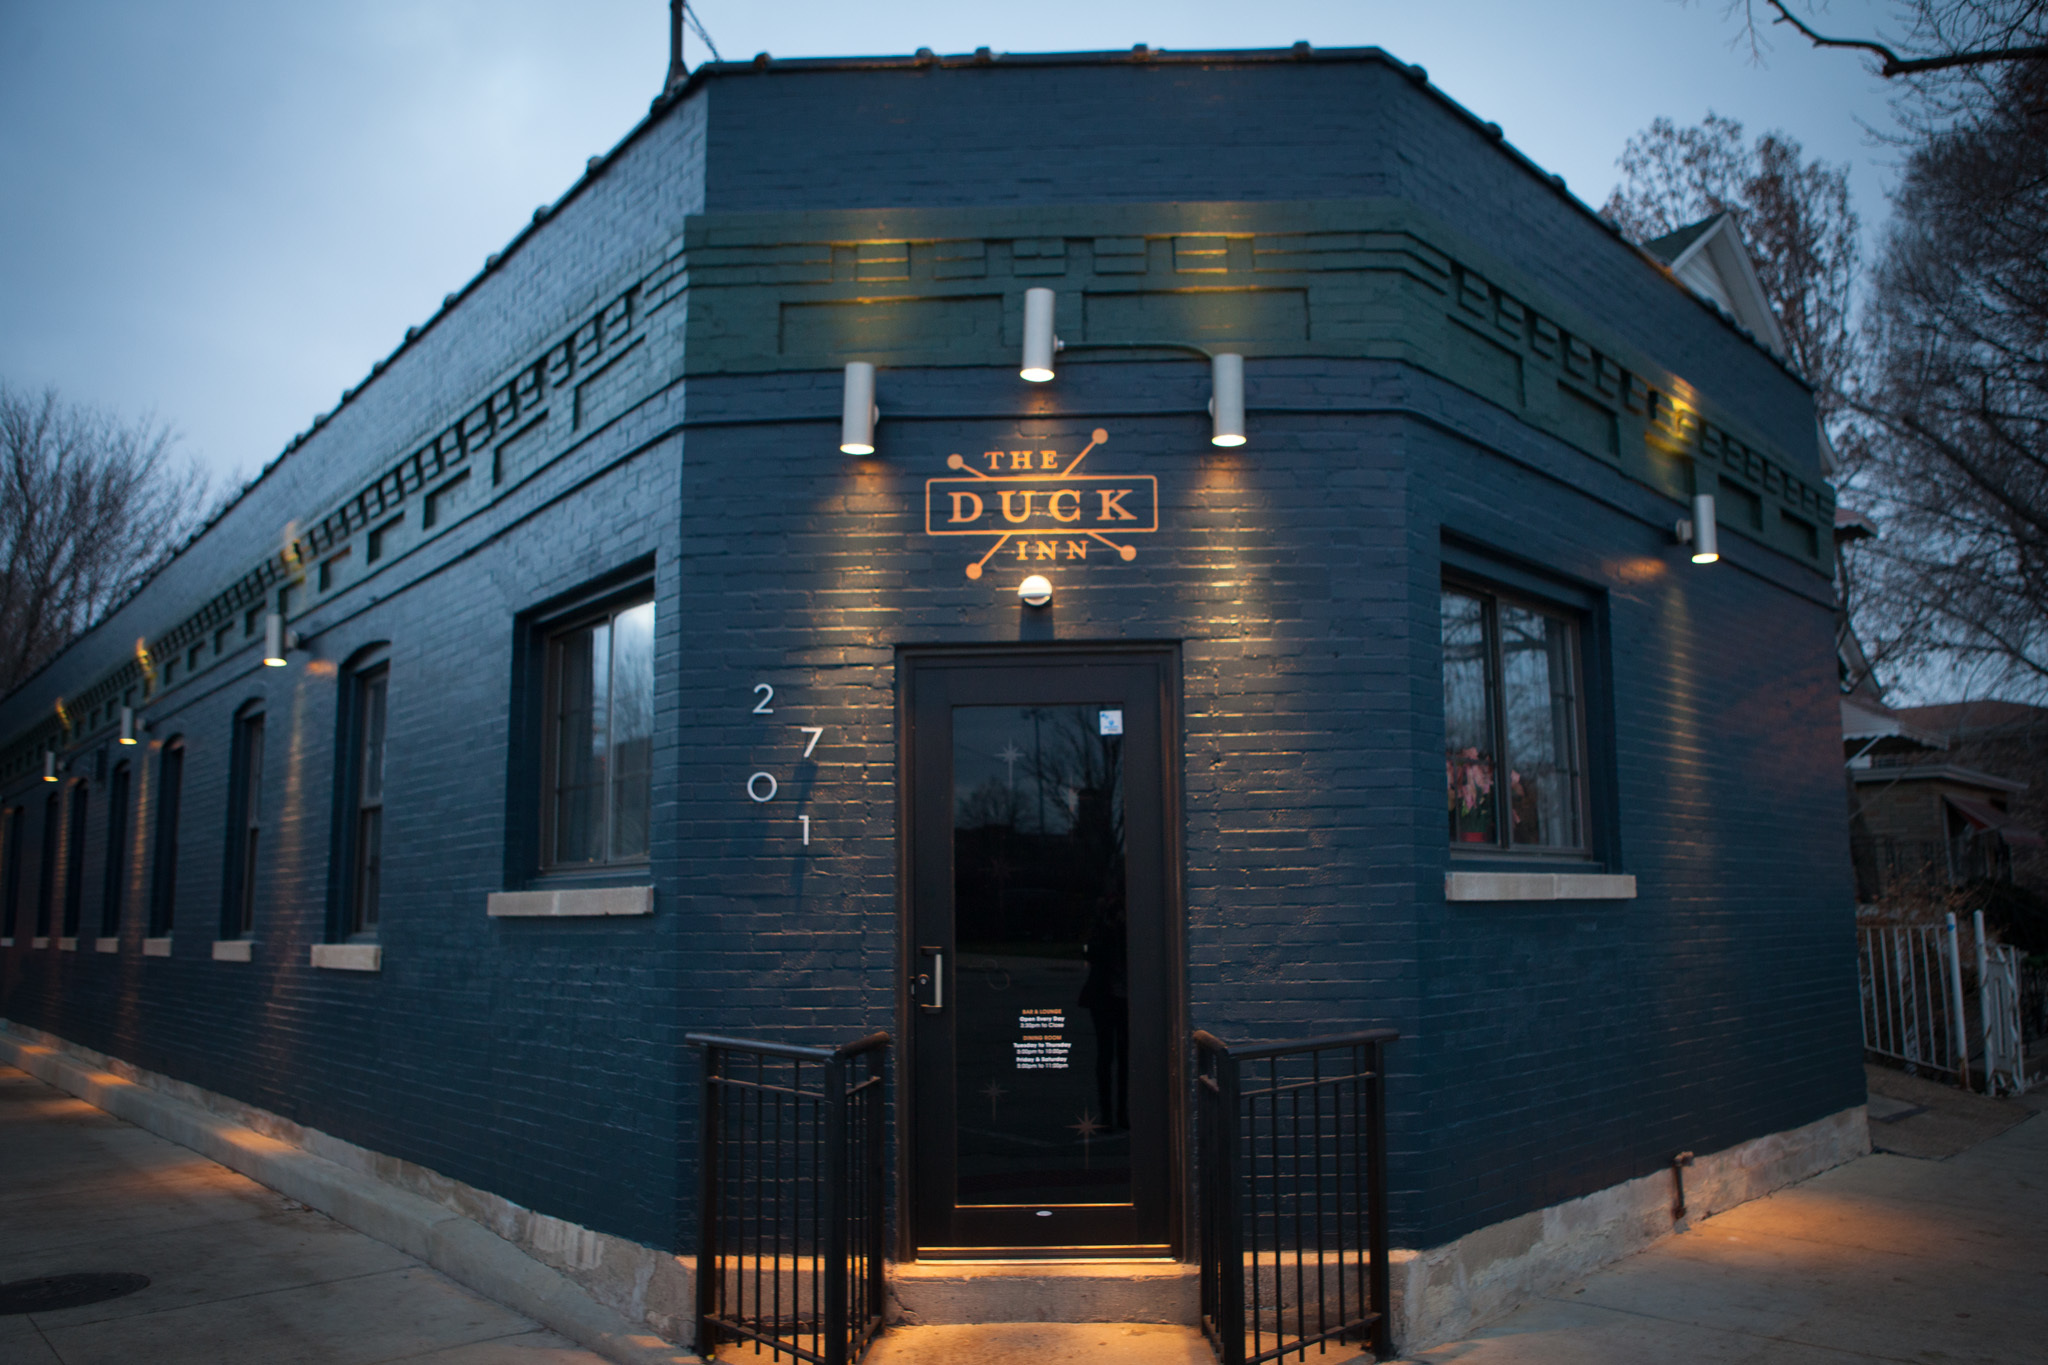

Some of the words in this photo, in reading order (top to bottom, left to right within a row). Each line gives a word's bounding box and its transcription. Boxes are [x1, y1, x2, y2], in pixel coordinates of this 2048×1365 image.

[984, 450, 1058, 470] THE
[947, 489, 1138, 524] DUCK
[1016, 540, 1089, 560] INN
